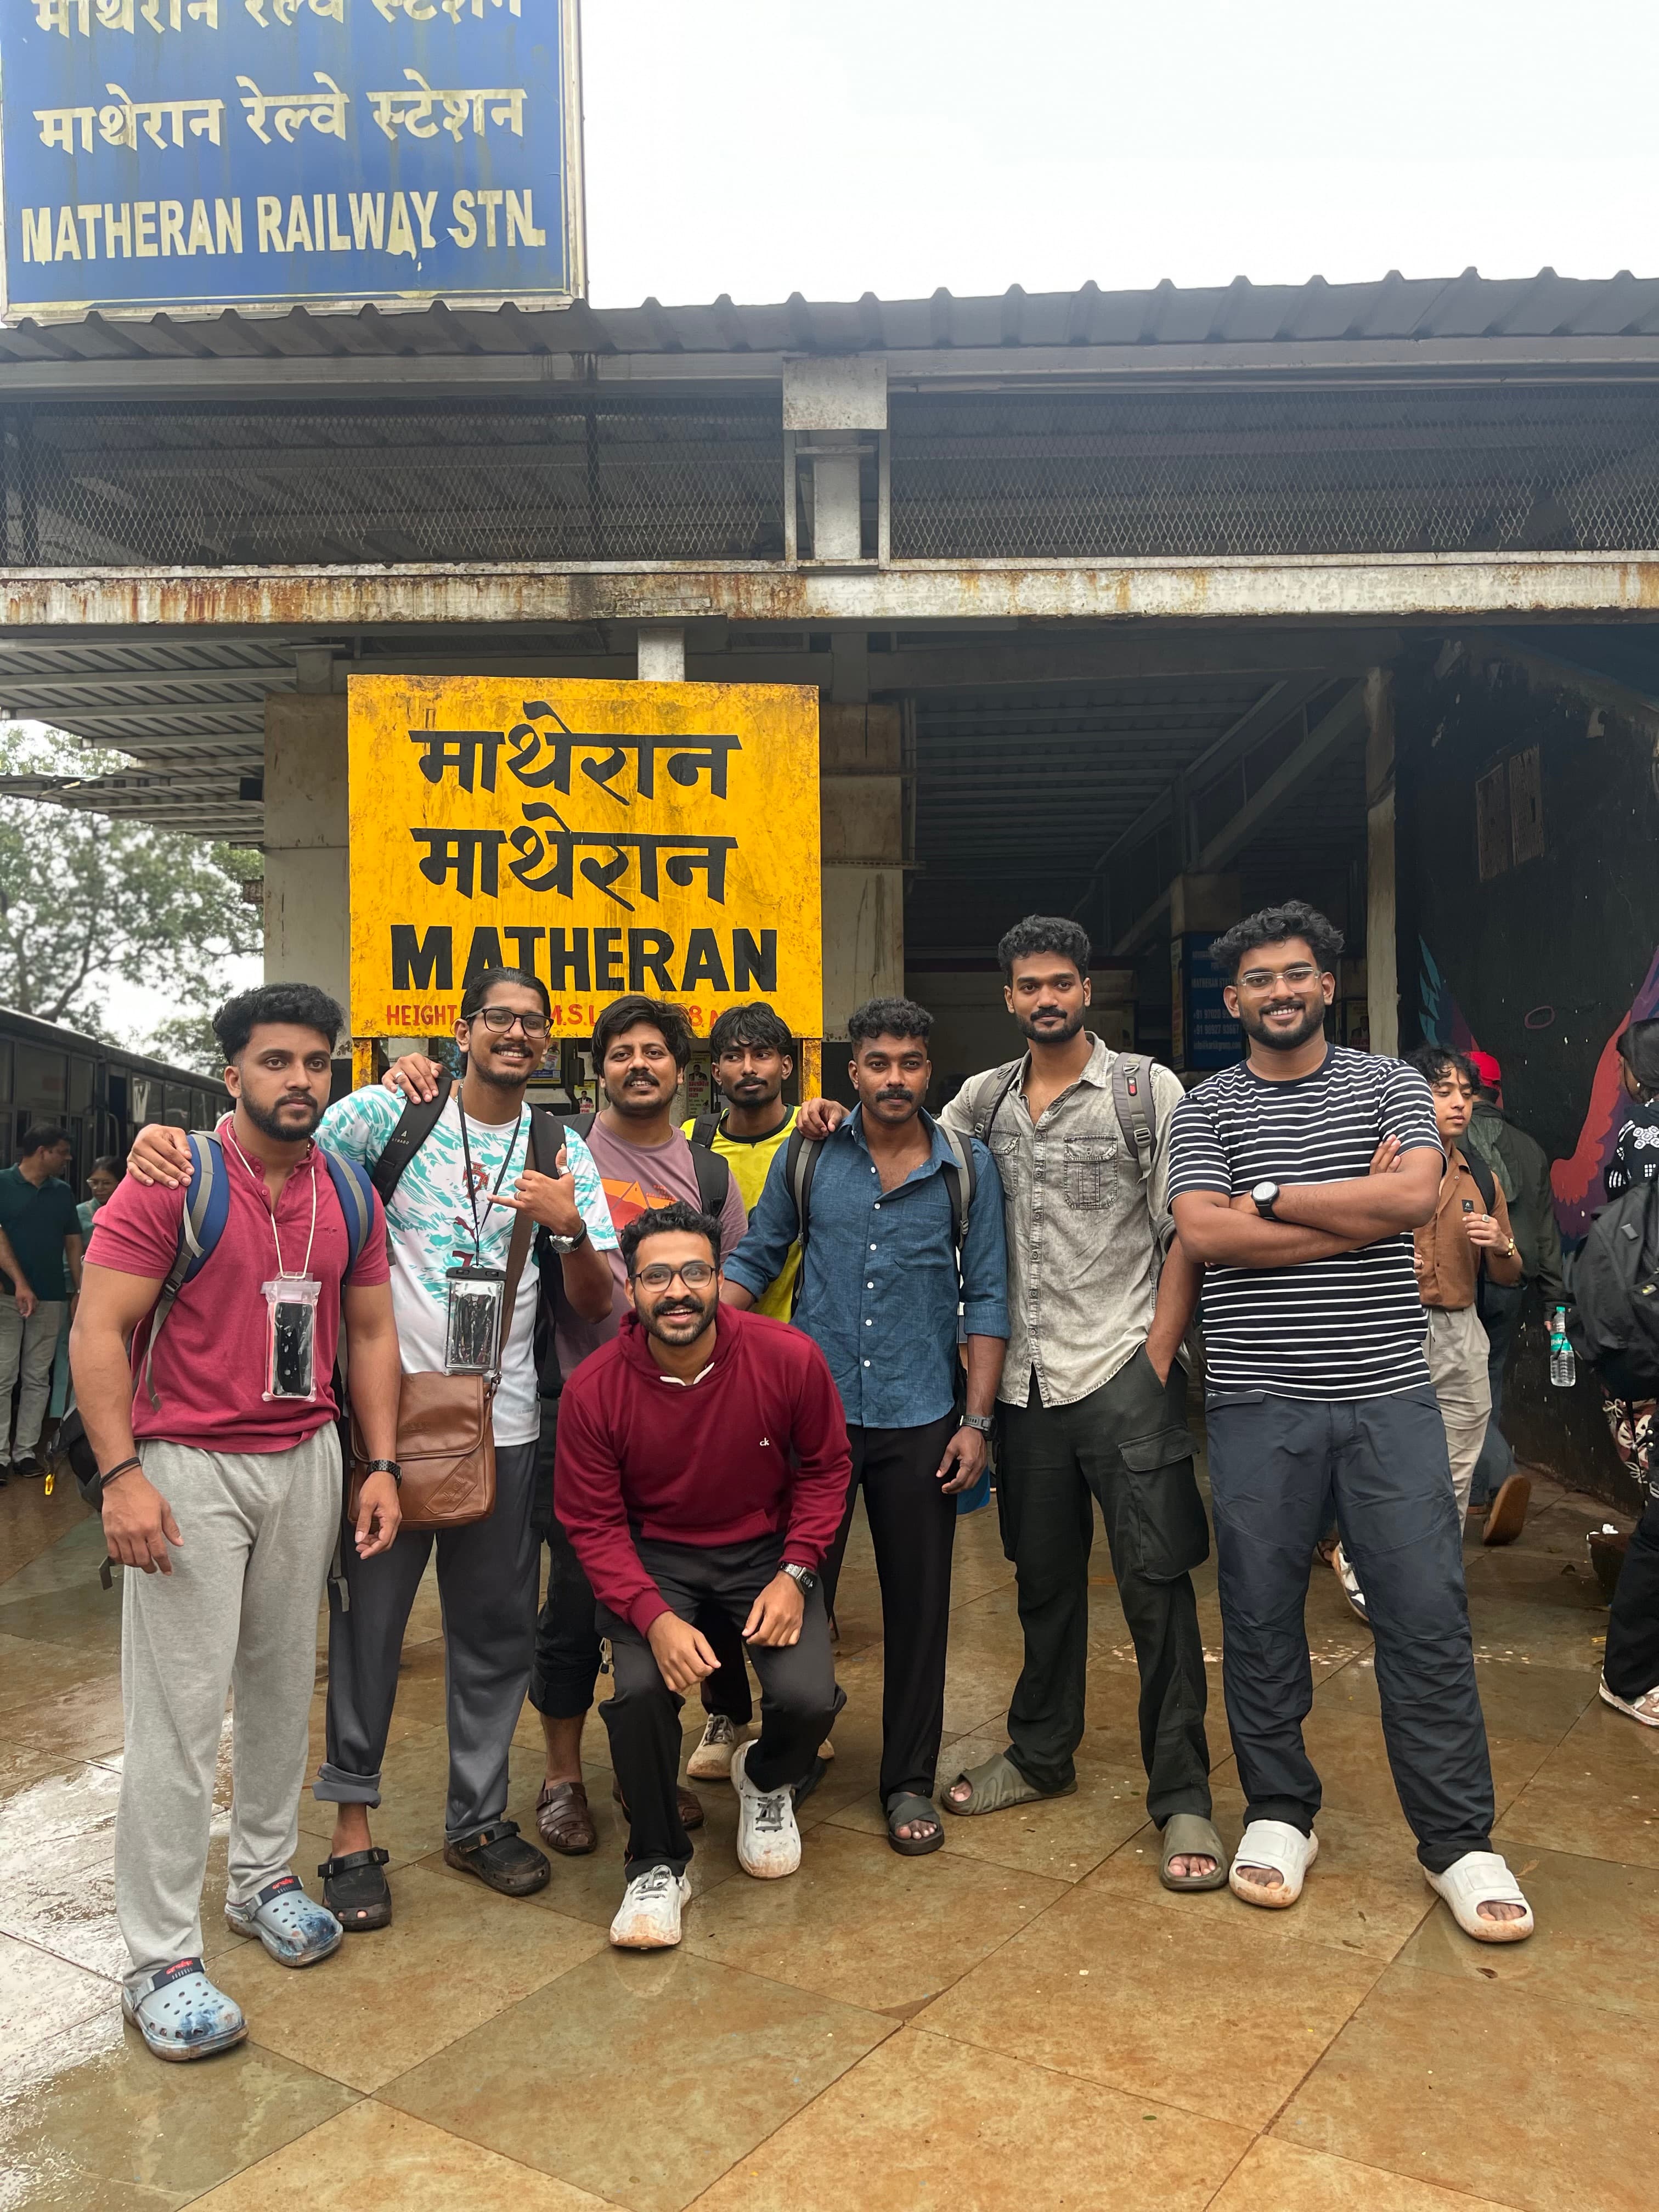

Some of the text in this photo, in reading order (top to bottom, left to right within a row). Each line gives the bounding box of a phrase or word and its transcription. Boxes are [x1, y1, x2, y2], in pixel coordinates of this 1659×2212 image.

[33, 69, 527, 154] माथेरान रेल्वे स्टेशन
[22, 198, 242, 263] MATHERAN
[257, 191, 438, 259] RAILWAY
[408, 701, 743, 806] माथेरान
[410, 803, 738, 911] माथेरान
[391, 925, 777, 992] MATHERAN
[387, 1005, 457, 1025] HEIGHT
